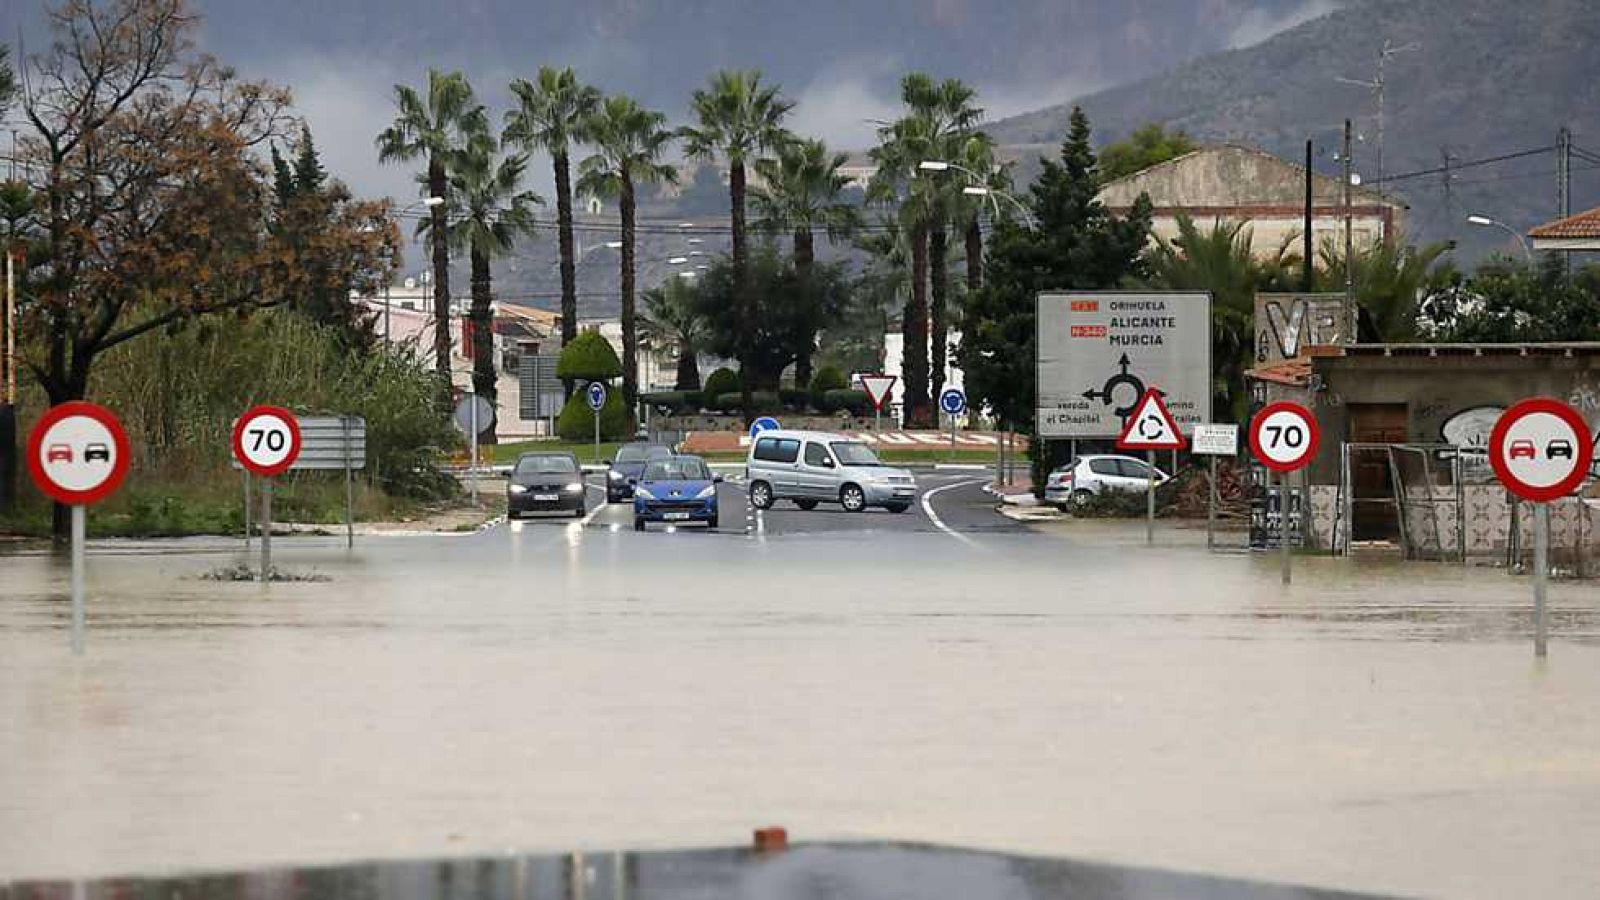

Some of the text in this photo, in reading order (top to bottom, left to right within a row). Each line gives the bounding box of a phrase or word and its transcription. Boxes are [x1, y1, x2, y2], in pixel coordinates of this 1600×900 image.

[1110, 301, 1165, 311] ORIHUELA
[1110, 316, 1176, 328] ALICANTE
[1109, 335, 1163, 346] MURCIA
[249, 429, 285, 452] 70
[1266, 425, 1303, 448] 70
